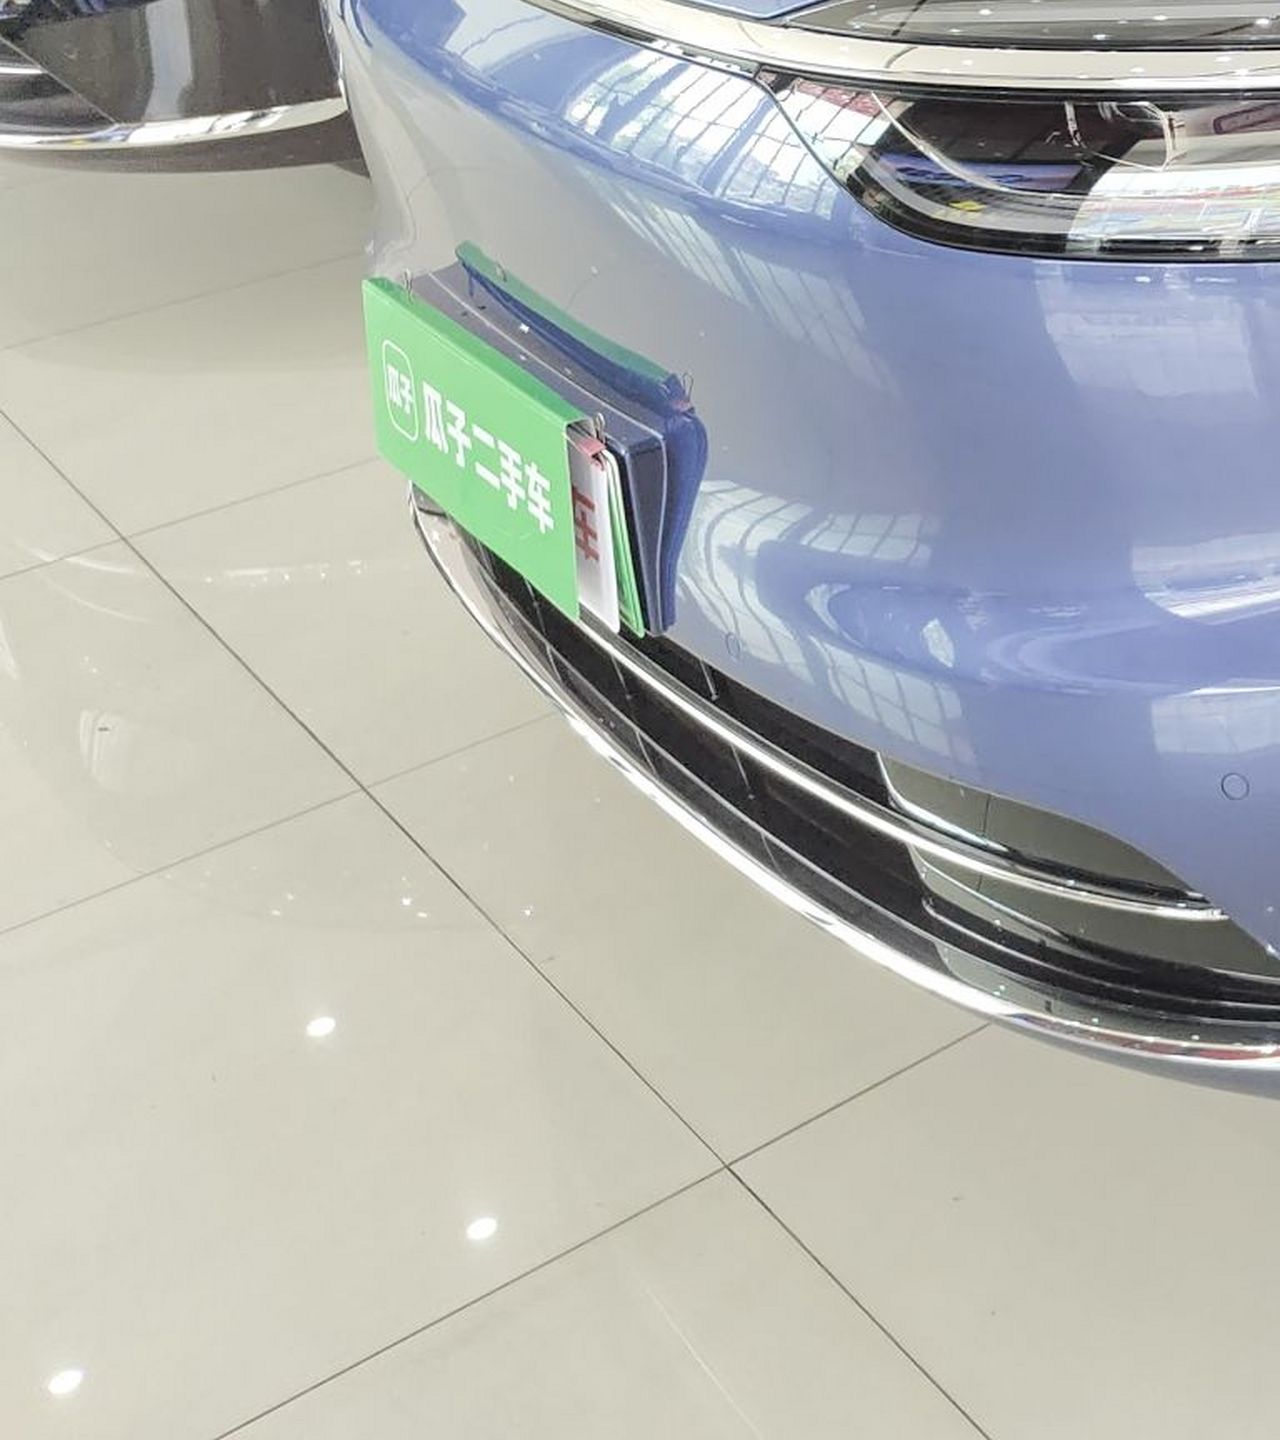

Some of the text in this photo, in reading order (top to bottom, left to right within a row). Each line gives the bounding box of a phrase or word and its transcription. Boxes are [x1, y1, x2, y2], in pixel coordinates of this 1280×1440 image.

[387, 364, 414, 413] 瓜子
[423, 381, 554, 533] 瓜子二手车
